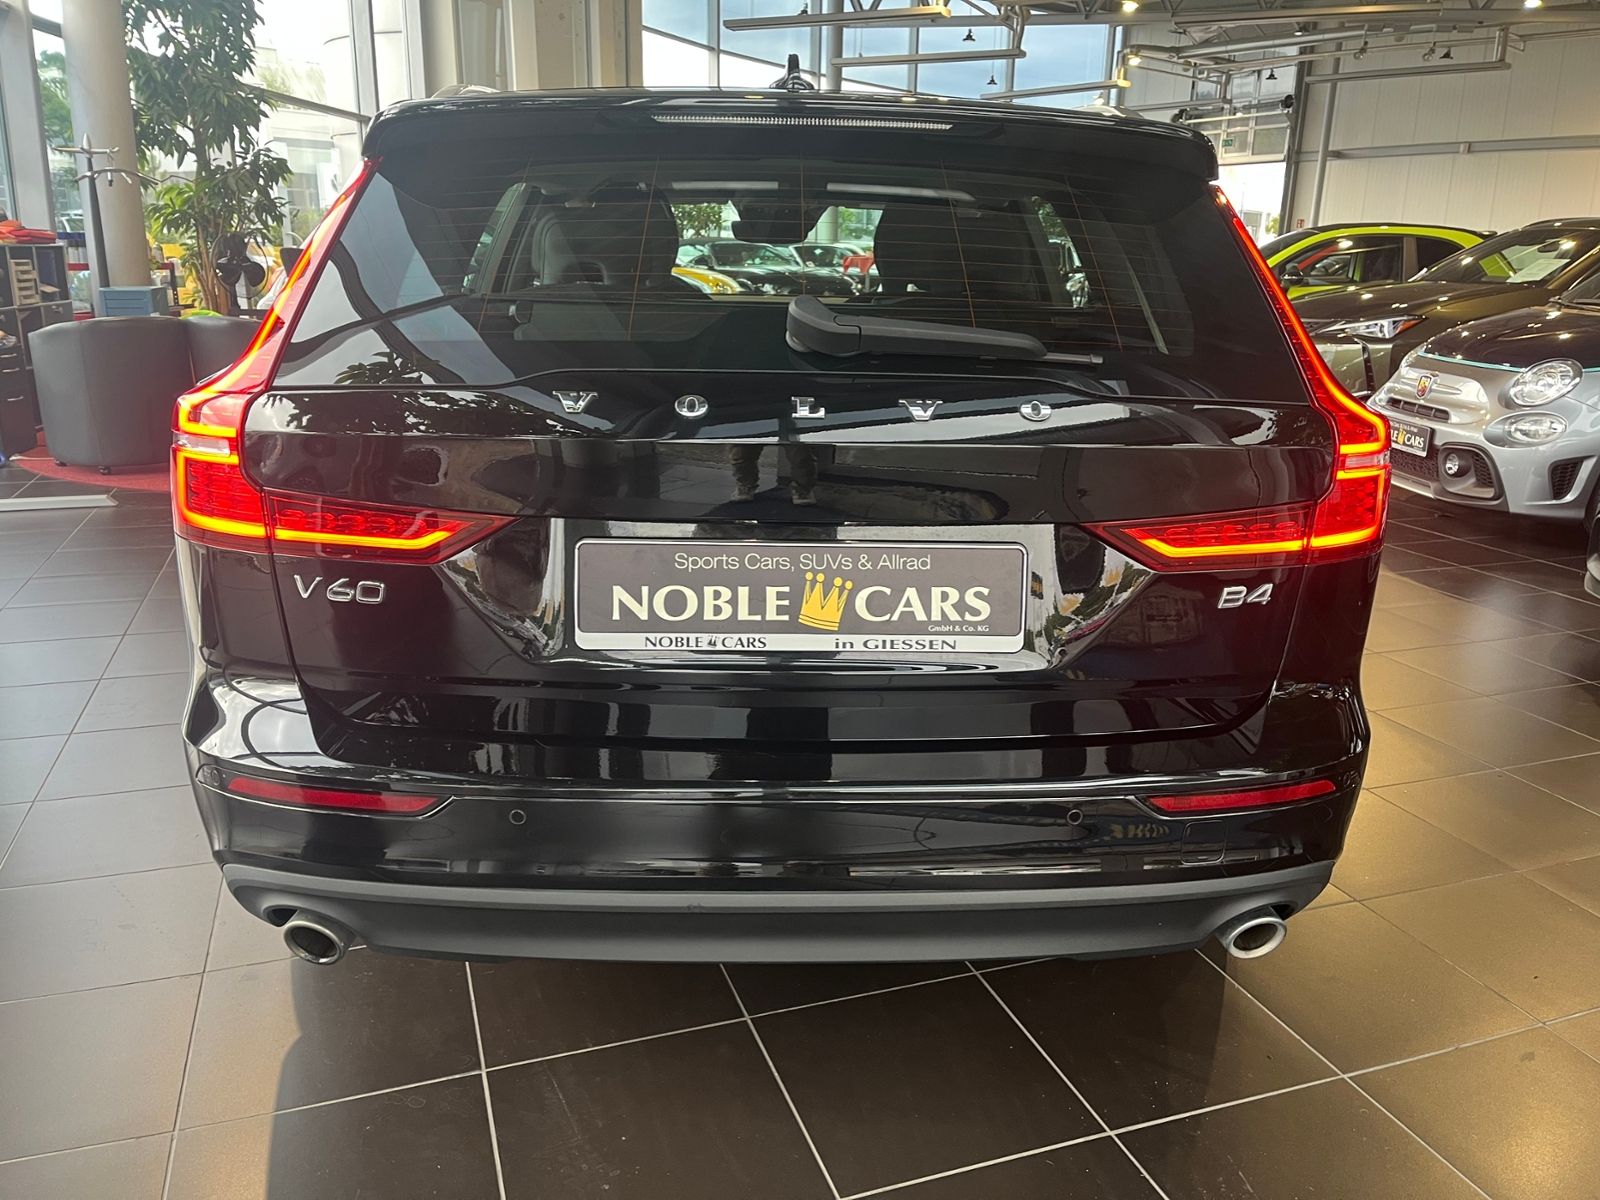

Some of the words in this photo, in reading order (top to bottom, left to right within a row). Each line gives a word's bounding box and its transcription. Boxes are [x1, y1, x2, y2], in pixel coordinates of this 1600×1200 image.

[552, 390, 1052, 422] VOLVO
[1404, 433, 1424, 448] CARS
[674, 552, 739, 572] Sports
[744, 553, 795, 572] Cars,
[799, 553, 852, 570] SUVs
[857, 554, 873, 570] &
[877, 554, 931, 570] Allrad
[293, 574, 385, 605] V60
[1217, 583, 1274, 609] B4
[611, 585, 791, 622] NOBLE
[854, 585, 992, 622] CARS
[928, 624, 953, 632] GmbH
[644, 636, 703, 648] NOBLE
[721, 637, 767, 649] CARS
[834, 638, 854, 649] in
[862, 639, 957, 650] GIESSEN
